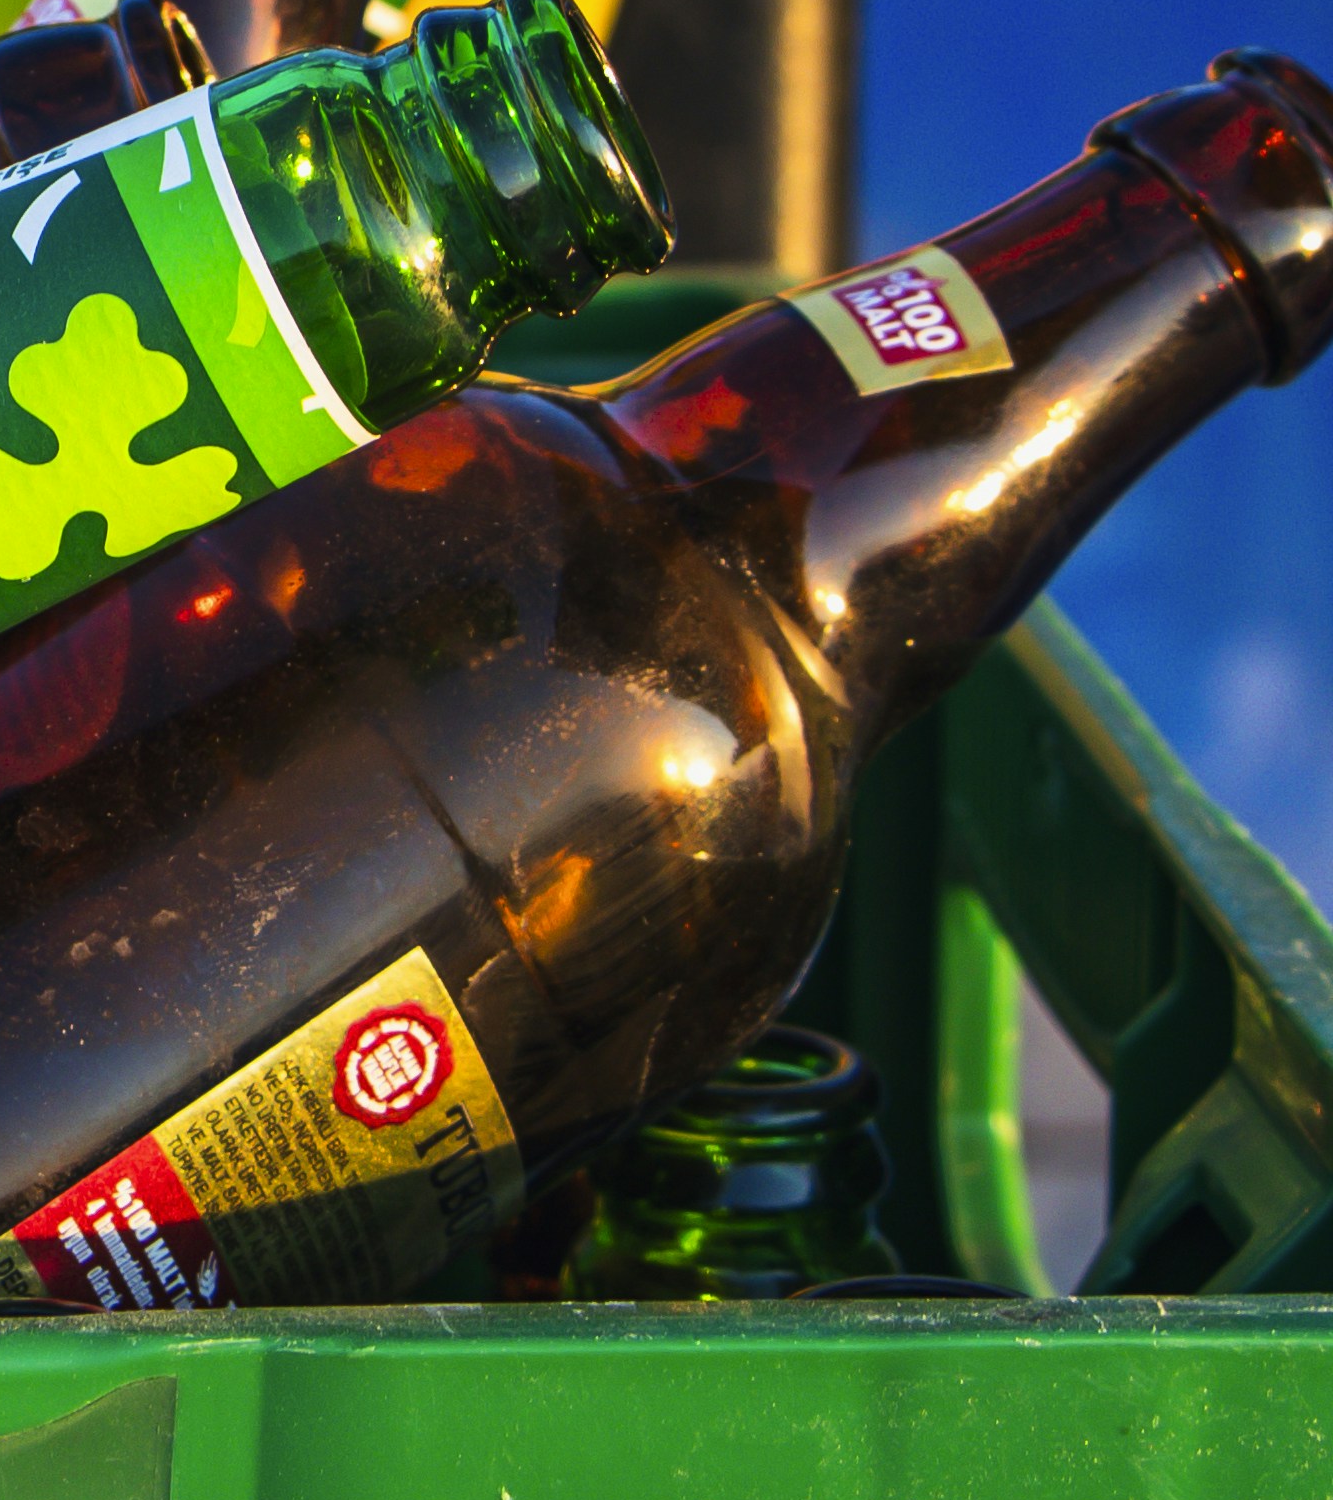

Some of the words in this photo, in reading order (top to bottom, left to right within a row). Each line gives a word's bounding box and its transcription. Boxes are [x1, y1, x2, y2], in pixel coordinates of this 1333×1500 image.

[845, 288, 915, 350] MALT
[883, 270, 960, 352] %100
[204, 1108, 245, 1169] OLARAK
[82, 1199, 106, 1217] 4
[107, 1177, 158, 1242] %100
[142, 1237, 186, 1293] MALT
